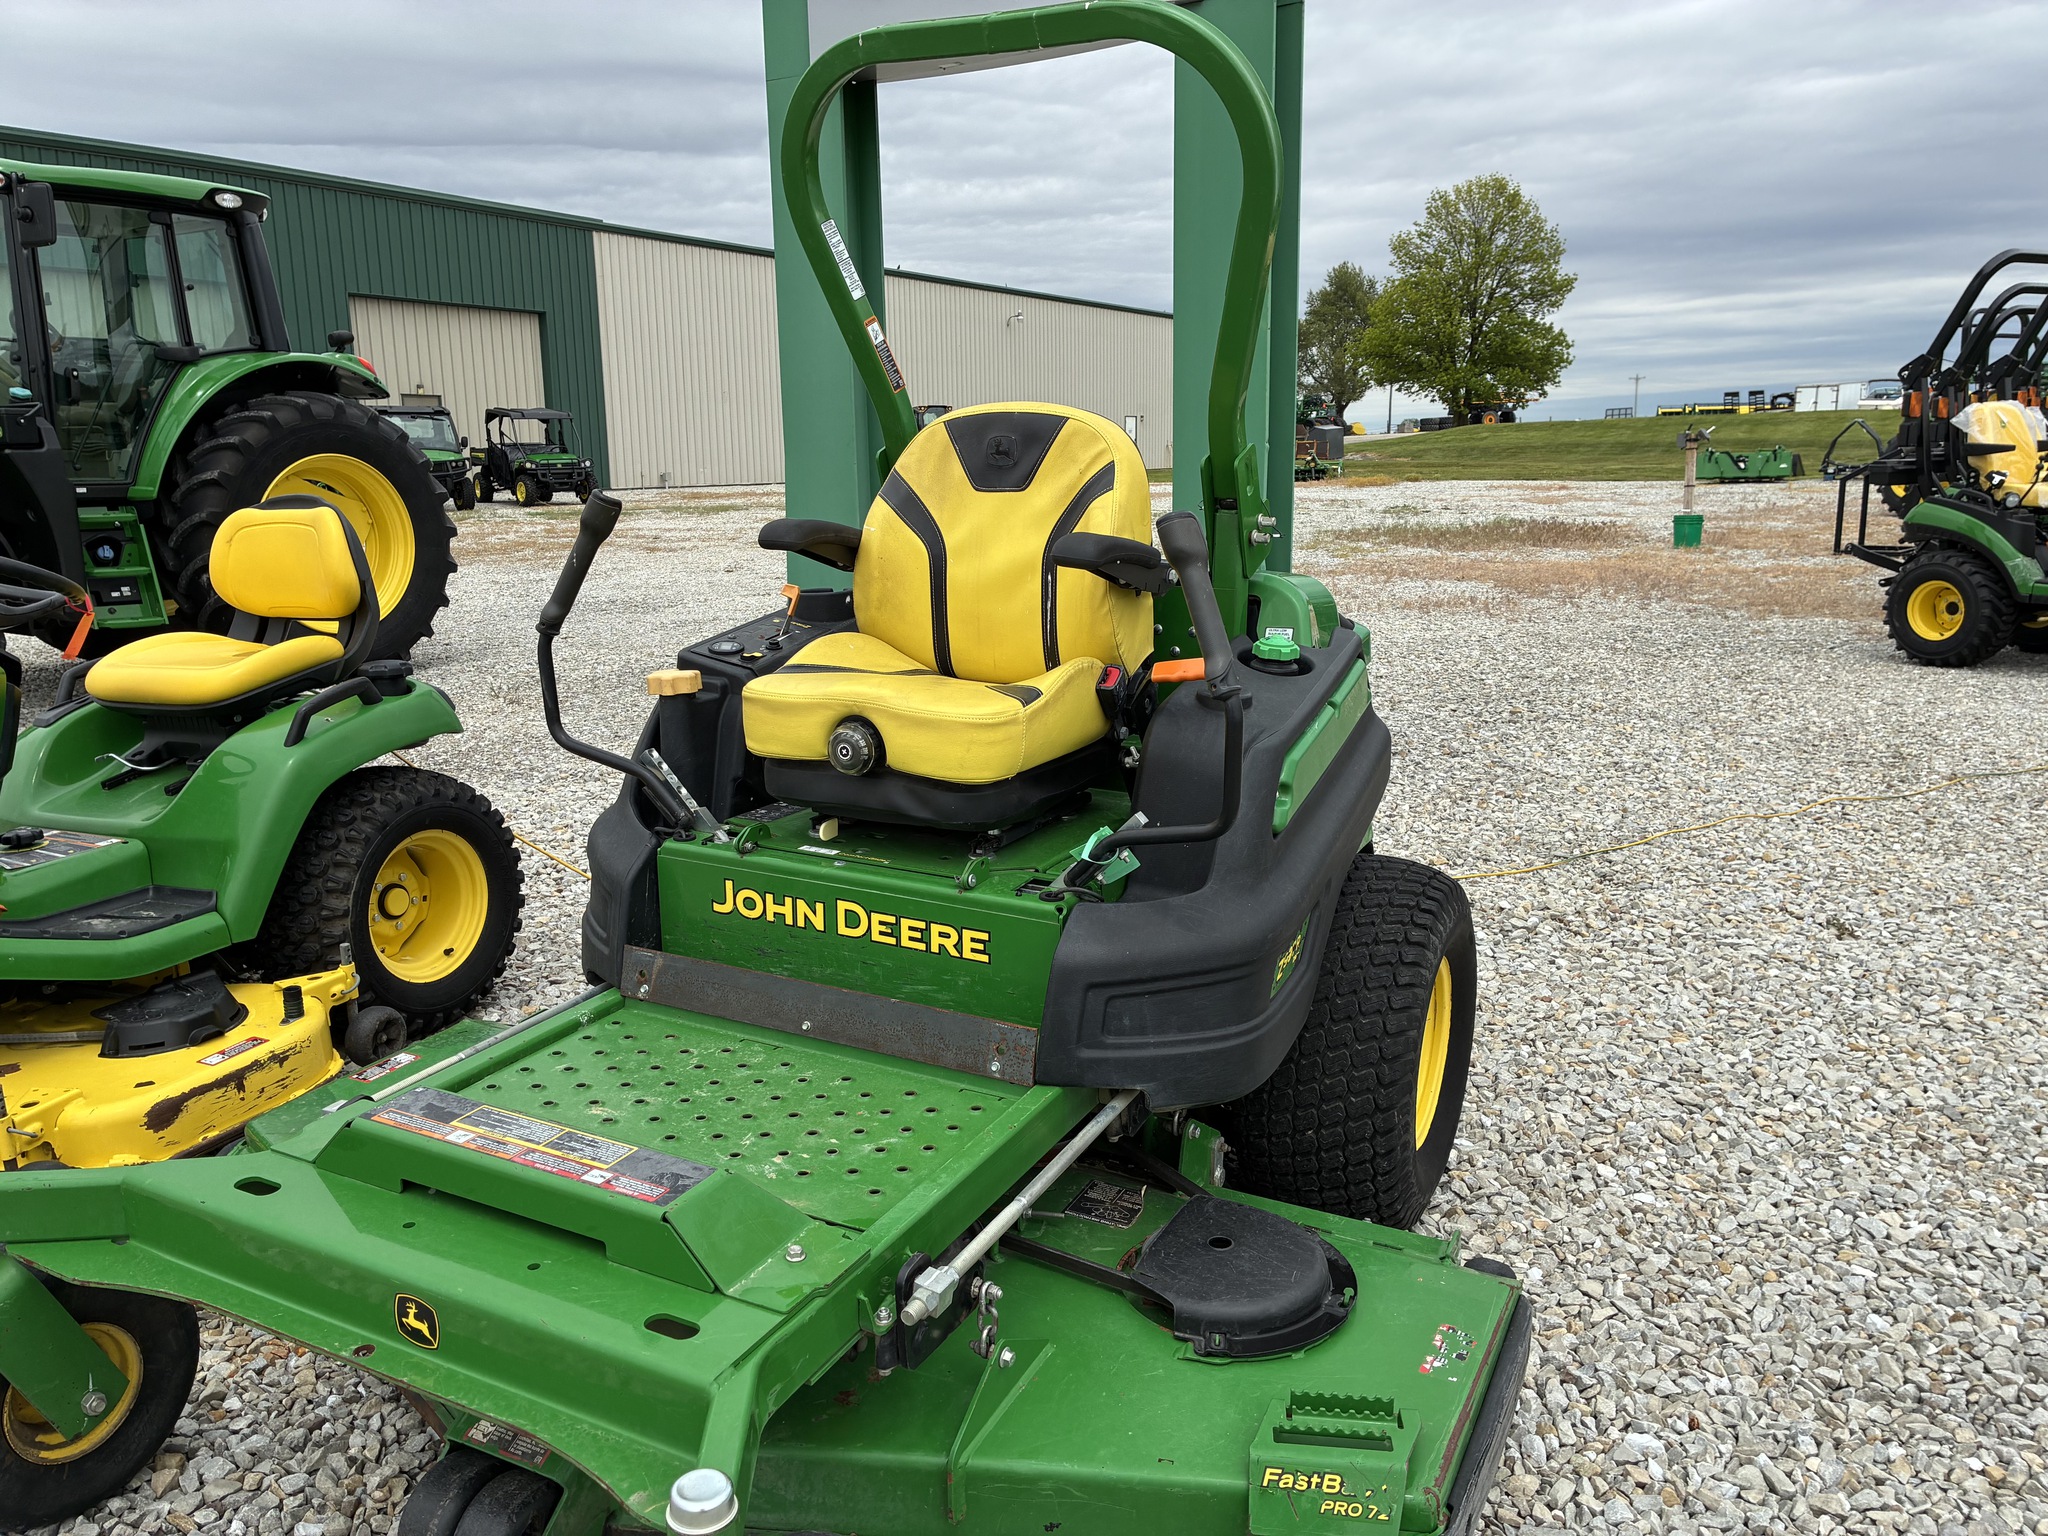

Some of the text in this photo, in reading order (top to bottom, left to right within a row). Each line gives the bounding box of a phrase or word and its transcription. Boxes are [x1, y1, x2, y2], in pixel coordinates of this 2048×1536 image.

[712, 878, 992, 965] JOHN DEERE
[1261, 1465, 1388, 1498] FastB
[1319, 1499, 1364, 1519] PRO
